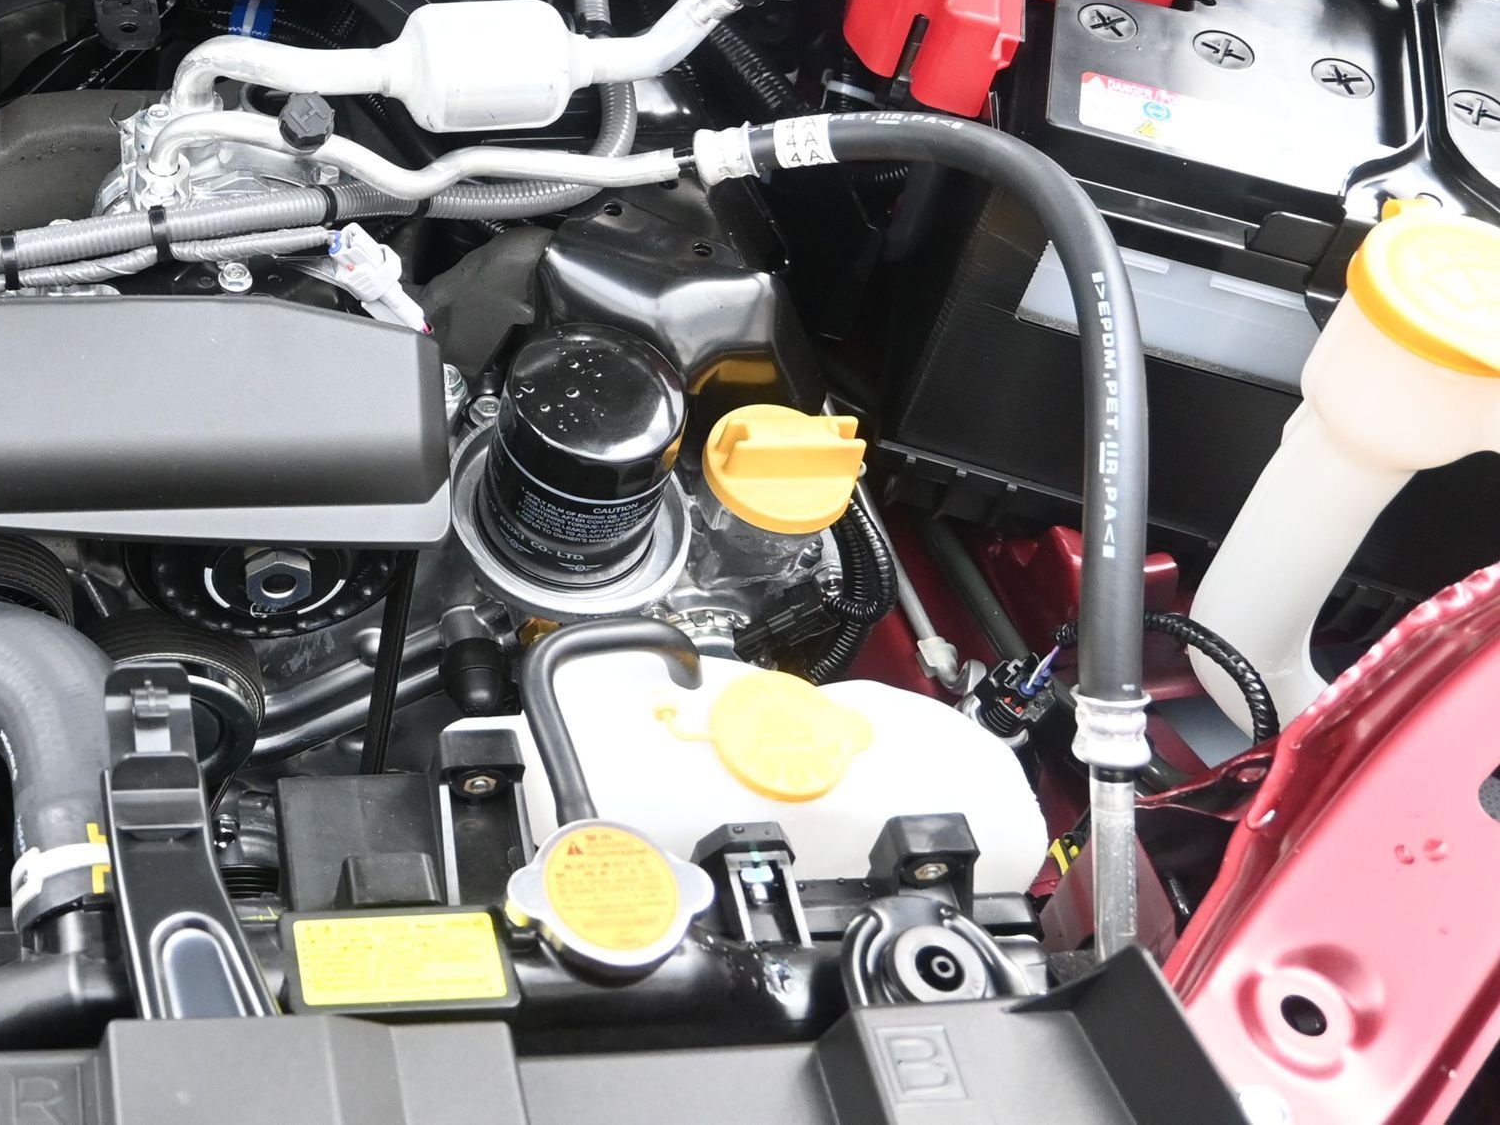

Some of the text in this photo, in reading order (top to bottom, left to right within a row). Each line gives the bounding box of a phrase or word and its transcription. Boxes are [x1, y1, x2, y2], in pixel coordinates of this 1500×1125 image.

[547, 503, 565, 514] FILM
[592, 502, 639, 515] CAUTION
[560, 514, 586, 524] AFTER
[586, 518, 621, 526] CONTACT
[588, 527, 613, 535] AFTER
